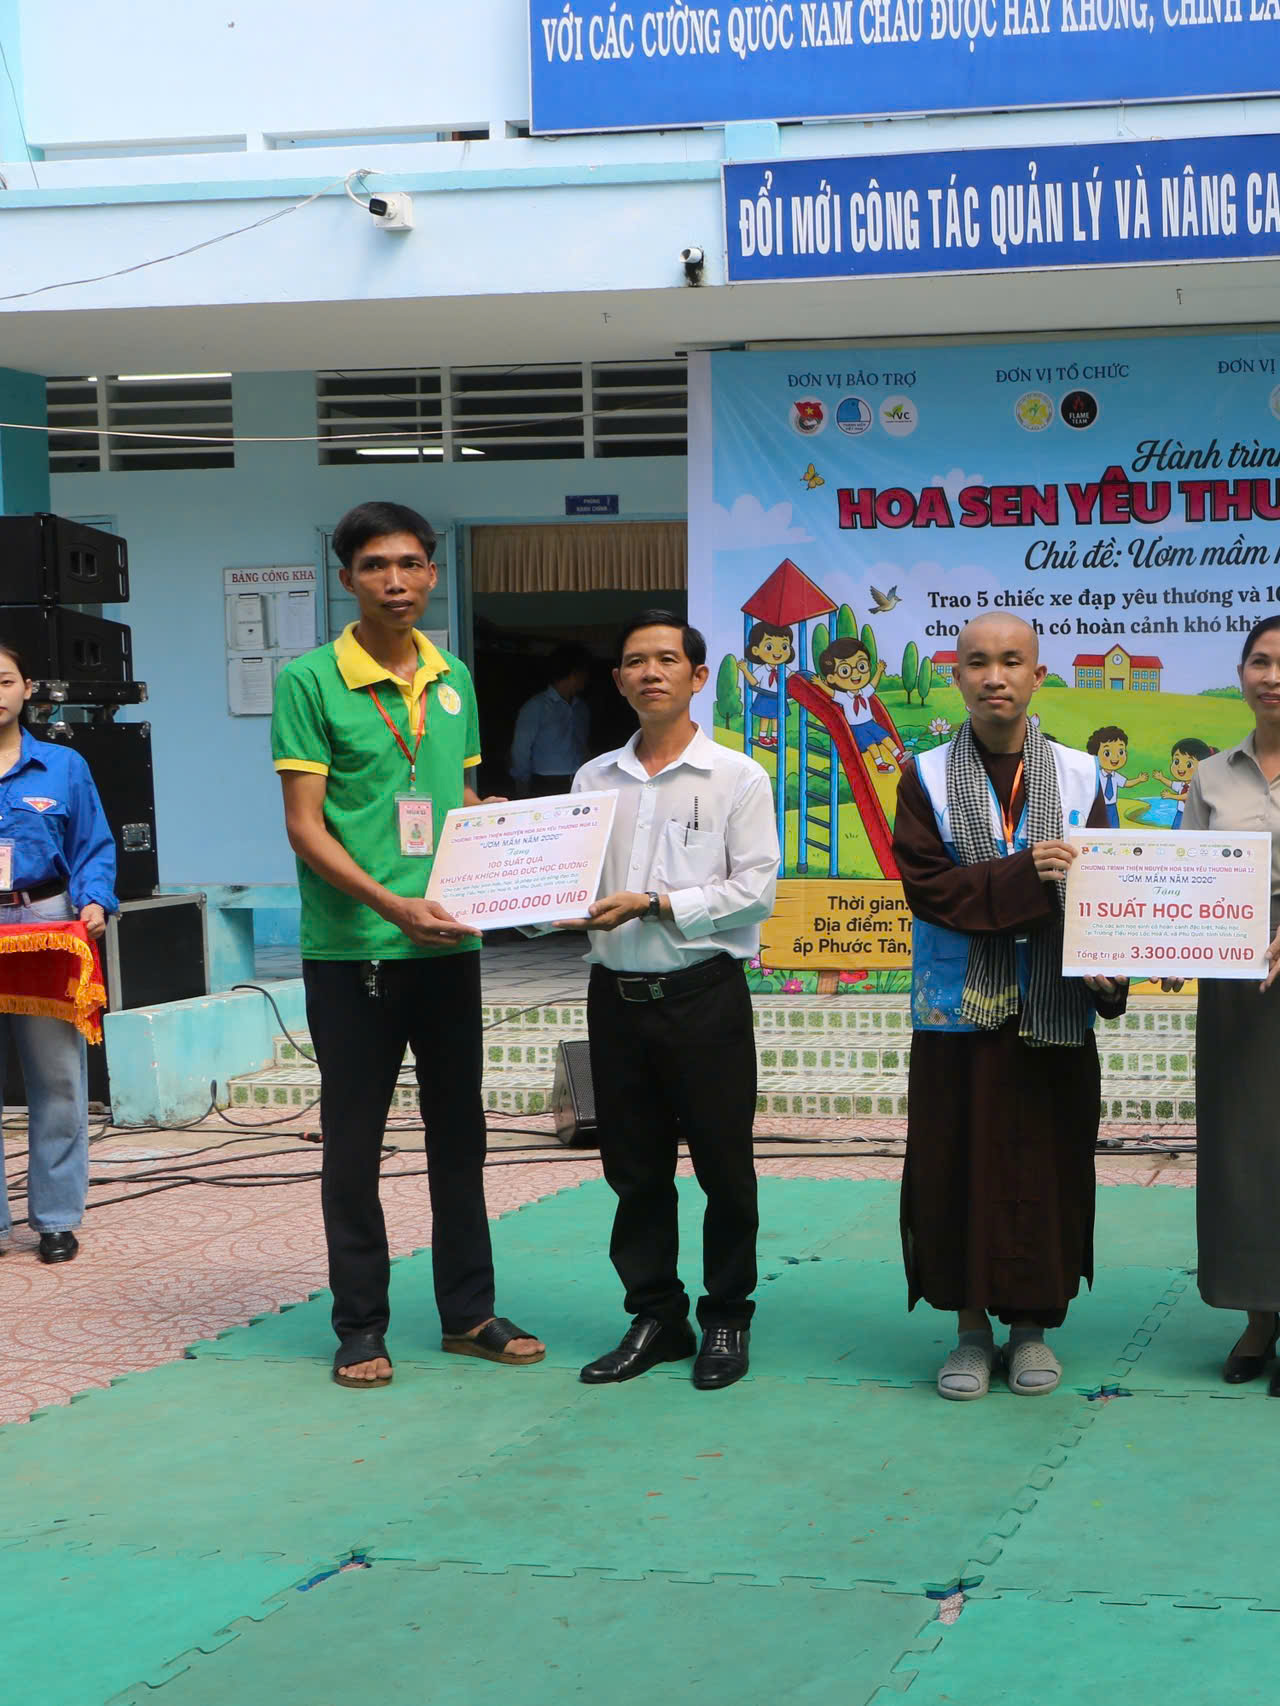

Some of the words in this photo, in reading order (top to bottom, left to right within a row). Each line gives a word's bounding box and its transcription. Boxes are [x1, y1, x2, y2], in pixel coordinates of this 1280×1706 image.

[542, 3, 583, 62] VỚI
[589, 2, 634, 60] CÁC
[641, 0, 721, 57] CƯỜNG
[739, 171, 783, 258] ĐỔI
[792, 179, 840, 255] MỚI
[849, 178, 919, 252] CÔNG
[928, 173, 980, 248] TÁC
[989, 160, 1064, 255] QUẢN
[1072, 165, 1102, 242] LÝ
[1114, 165, 1152, 240] VÀ
[1161, 163, 1236, 237] NÂNG
[995, 368, 1031, 383] ĐƠN
[1035, 367, 1052, 384] VỊ
[1055, 363, 1079, 381] TỔ
[1083, 363, 1130, 380] CHỨC
[1218, 357, 1254, 374] ĐƠN
[1258, 358, 1275, 374] VỊ
[787, 373, 822, 387] ĐƠN
[825, 372, 842, 389] VỊ
[846, 369, 879, 386] BẢO
[882, 370, 917, 389] TRỢ
[1131, 439, 1223, 472] Hành
[837, 486, 955, 529] HOA
[959, 484, 1060, 528] SEN
[1066, 465, 1172, 526] YÊU
[1024, 534, 1078, 569] Chủ
[1082, 537, 1120, 568] đề:
[1127, 536, 1197, 568] Ươm
[1201, 533, 1273, 566] mầm
[927, 591, 971, 608] Trao
[977, 591, 989, 607] 5
[993, 587, 1045, 607] chiếc
[1050, 593, 1073, 606] xe
[1078, 587, 1116, 610] đạp
[1122, 589, 1158, 610] yêu
[1163, 587, 1234, 608] thương
[1238, 586, 1261, 603] và
[925, 620, 960, 637] cho
[1049, 618, 1071, 635] có
[1076, 618, 1125, 635] hoàn
[1130, 616, 1179, 634] cảnh
[1184, 615, 1221, 633] khó
[471, 894, 551, 915] 10.000.000
[556, 890, 588, 905] VNĐ
[828, 895, 864, 911] Thời
[1078, 902, 1091, 917] 11
[1097, 897, 1147, 918] SUẤT
[1153, 903, 1193, 921] HỌC
[1199, 897, 1254, 920] BỔNG
[813, 917, 840, 936] Địa
[846, 914, 893, 933] điểm:
[793, 936, 813, 957] ấp
[818, 938, 872, 954] Phước
[877, 938, 912, 956] Tân,
[1130, 946, 1213, 960] 3.300.000
[1219, 947, 1254, 960] VNĐ
